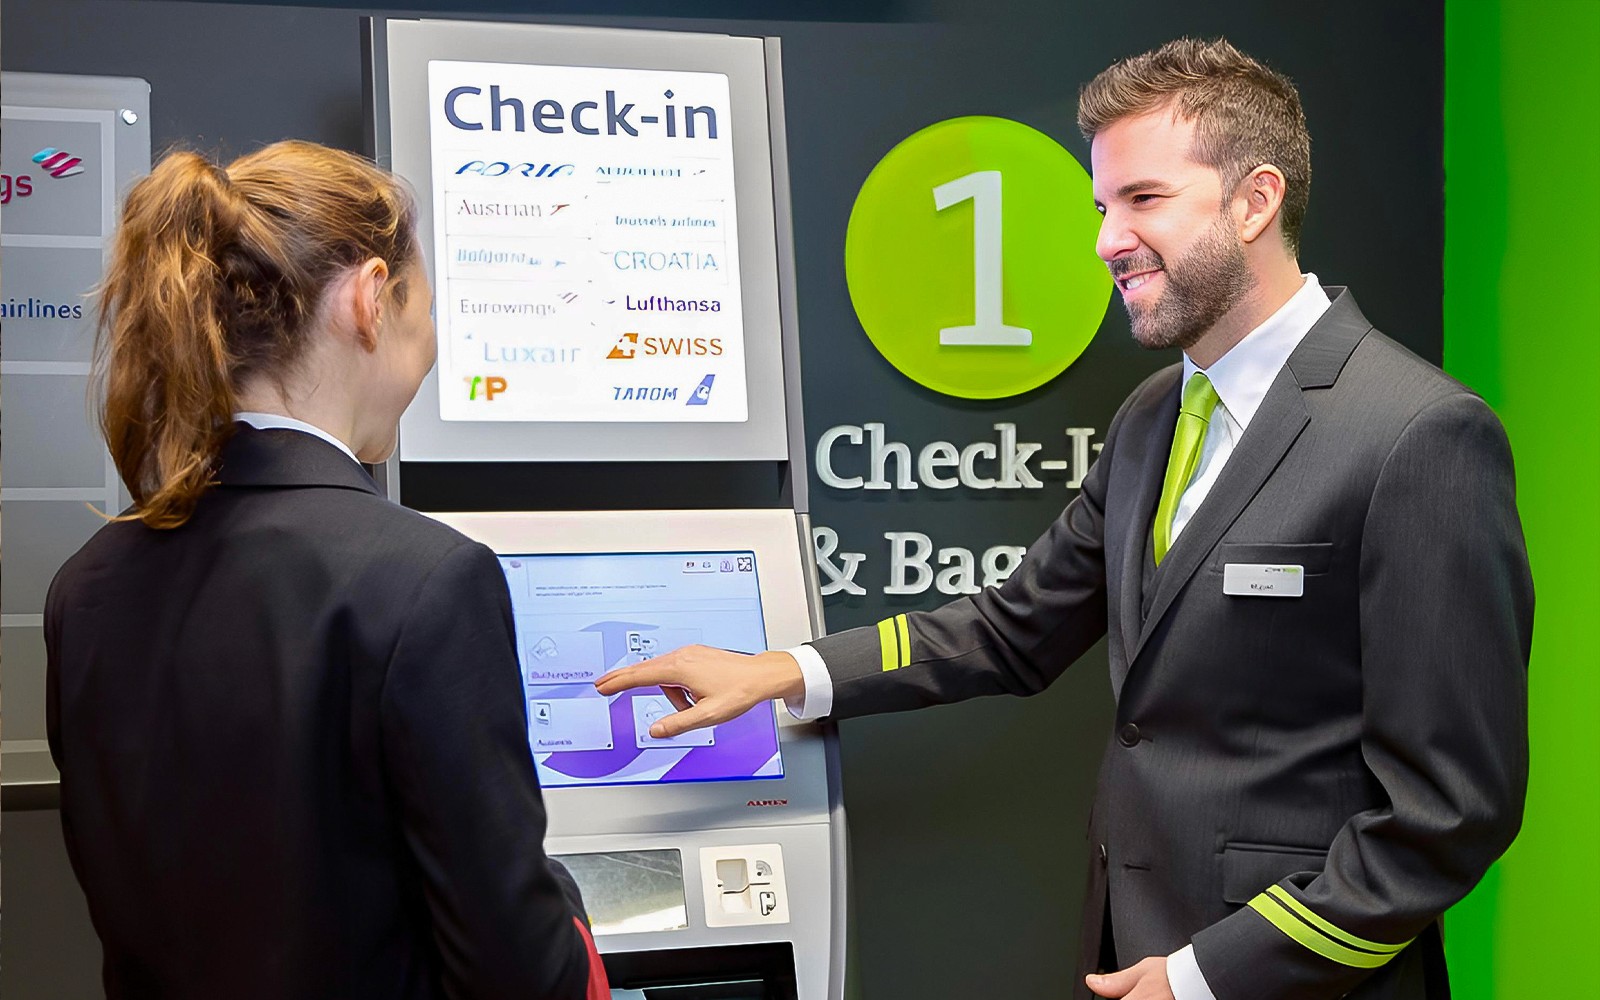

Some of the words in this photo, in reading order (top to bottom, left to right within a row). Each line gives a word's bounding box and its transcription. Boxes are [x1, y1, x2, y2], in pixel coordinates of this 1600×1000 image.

[444, 85, 718, 139] Check-in
[457, 199, 542, 217] Austrian
[614, 250, 719, 271] CROATIA
[932, 170, 1033, 346] 1
[460, 299, 556, 316] Eurowings
[625, 295, 721, 312] Lufthansa
[483, 342, 581, 363] Luxair
[643, 337, 723, 356] SWISS
[815, 423, 1104, 489] Check-I
[812, 526, 866, 595] &
